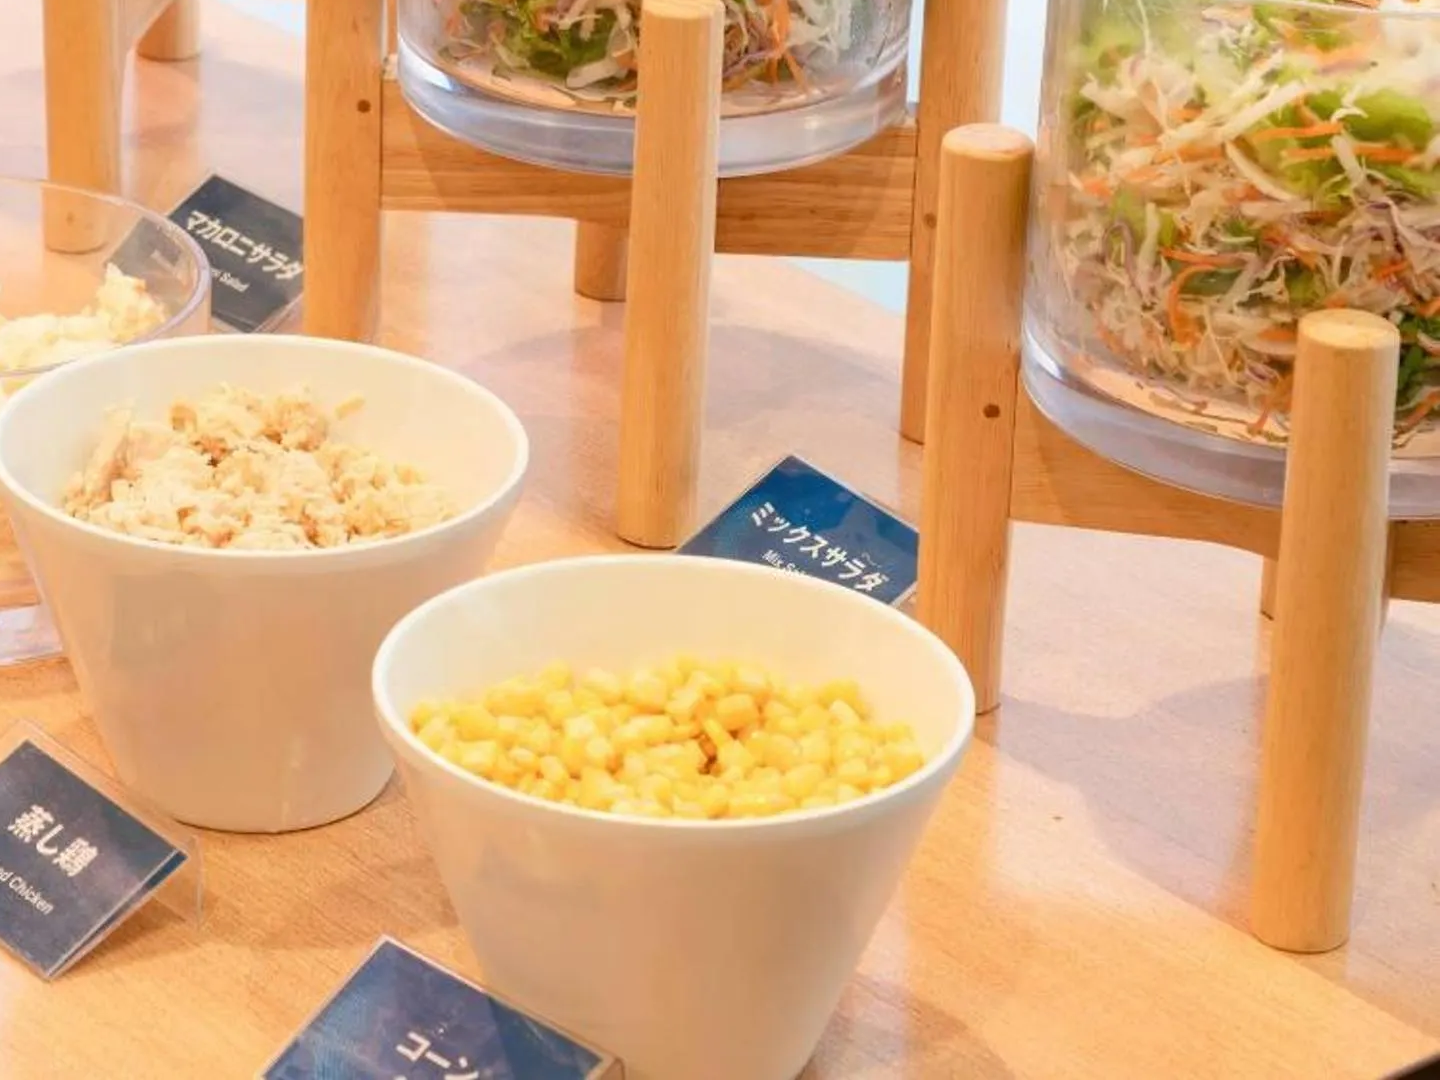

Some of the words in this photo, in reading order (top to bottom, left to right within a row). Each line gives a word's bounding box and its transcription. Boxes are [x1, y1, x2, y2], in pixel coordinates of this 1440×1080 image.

[750, 501, 889, 591] ミックスサラダ
[7, 804, 98, 877] 蒸し鶏
[8, 875, 55, 916] Chicken
[396, 1031, 479, 1080] コーン
